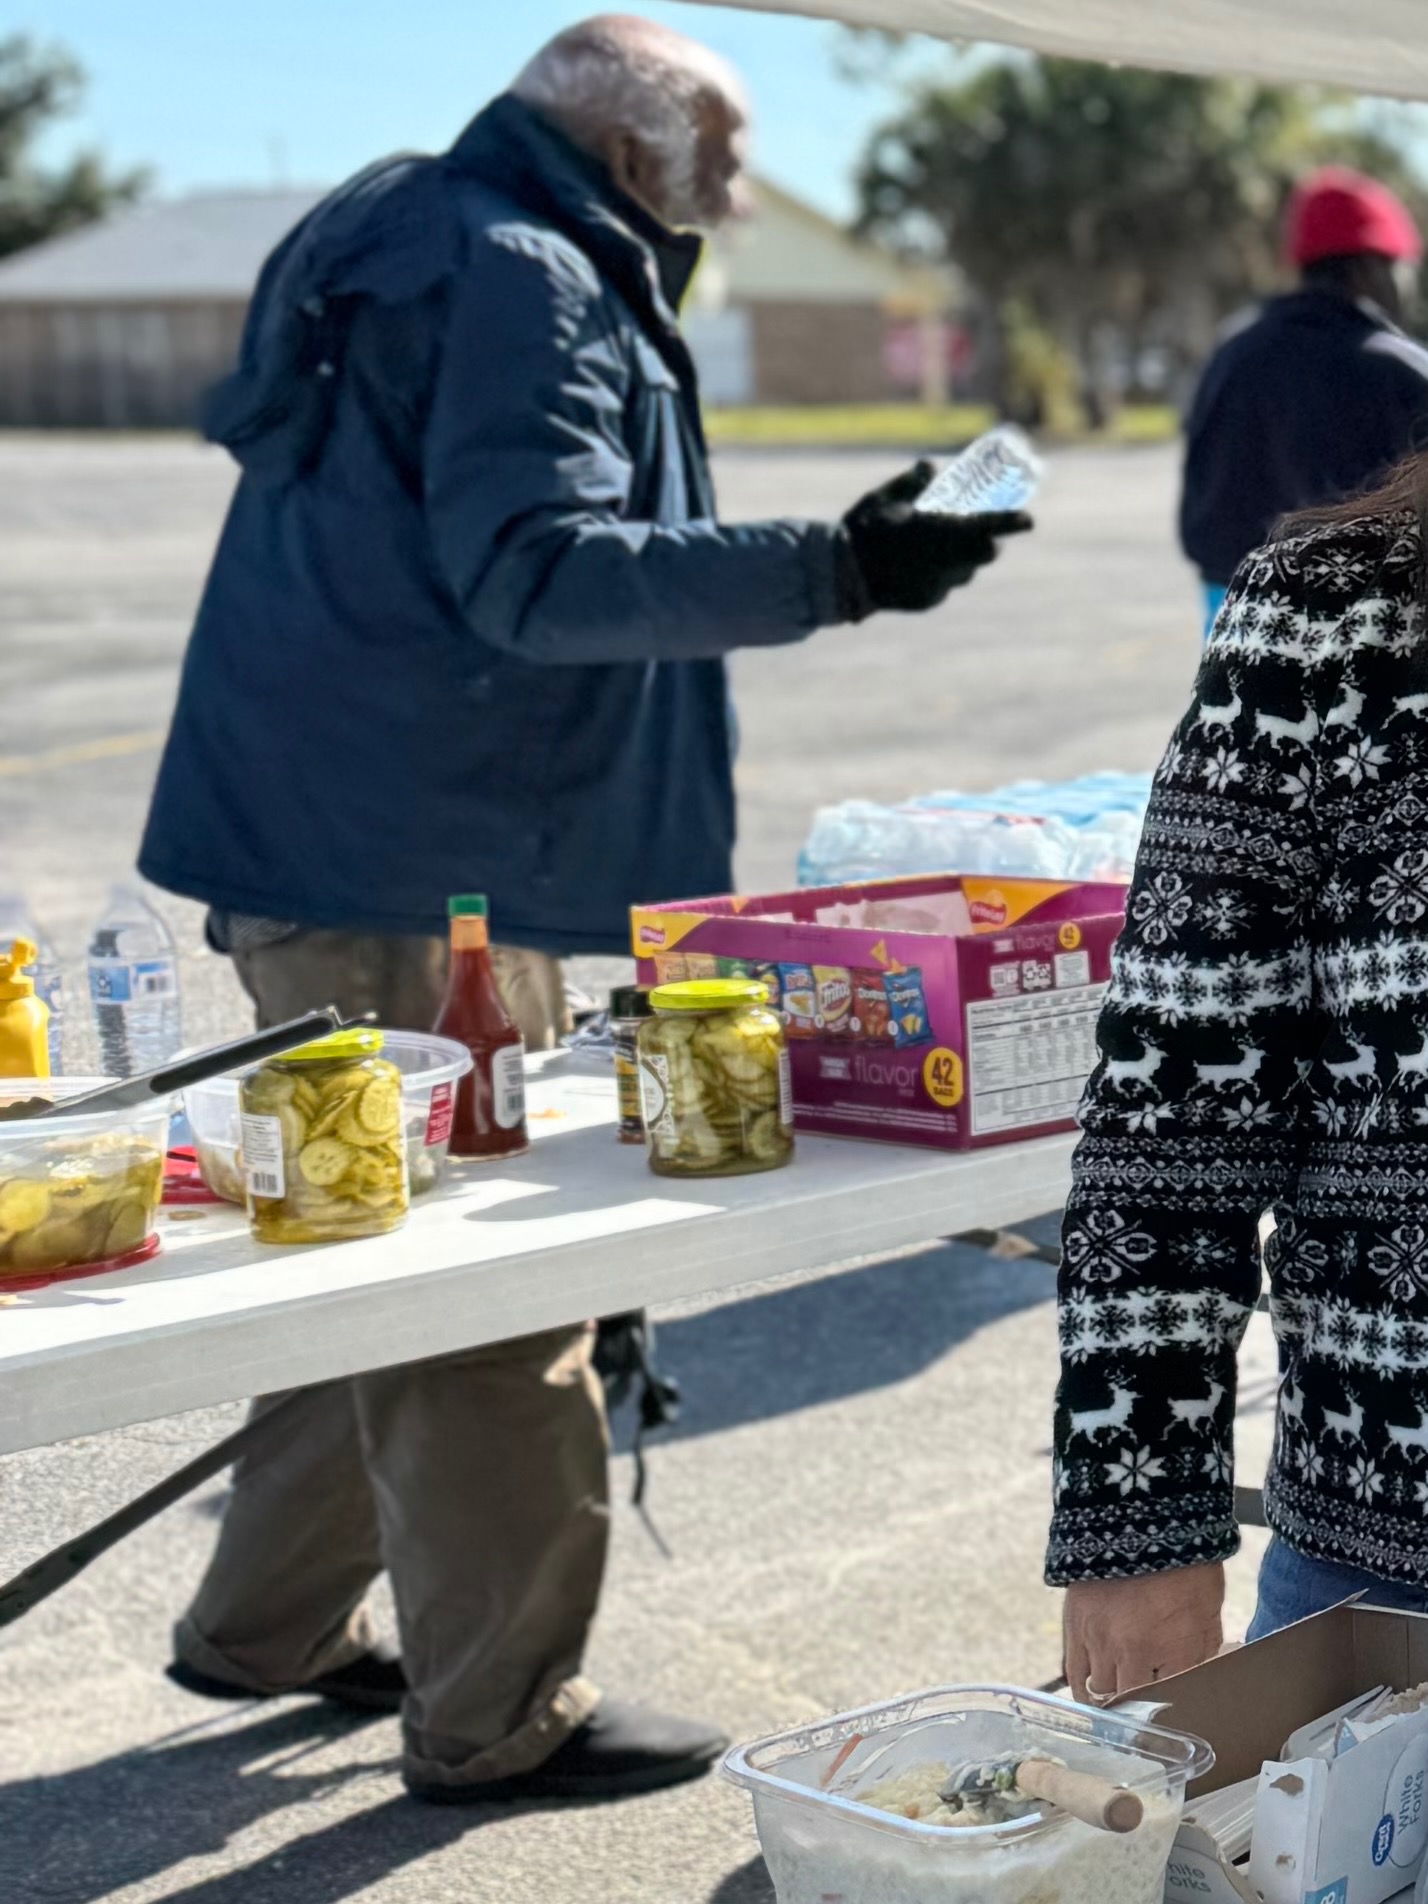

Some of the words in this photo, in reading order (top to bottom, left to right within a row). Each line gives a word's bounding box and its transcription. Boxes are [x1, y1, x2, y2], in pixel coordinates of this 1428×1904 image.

[854, 1055, 918, 1087] flavor
[931, 1056, 955, 1087] 42
[1166, 1860, 1206, 1879] hite
[1169, 1875, 1212, 1893] orks
